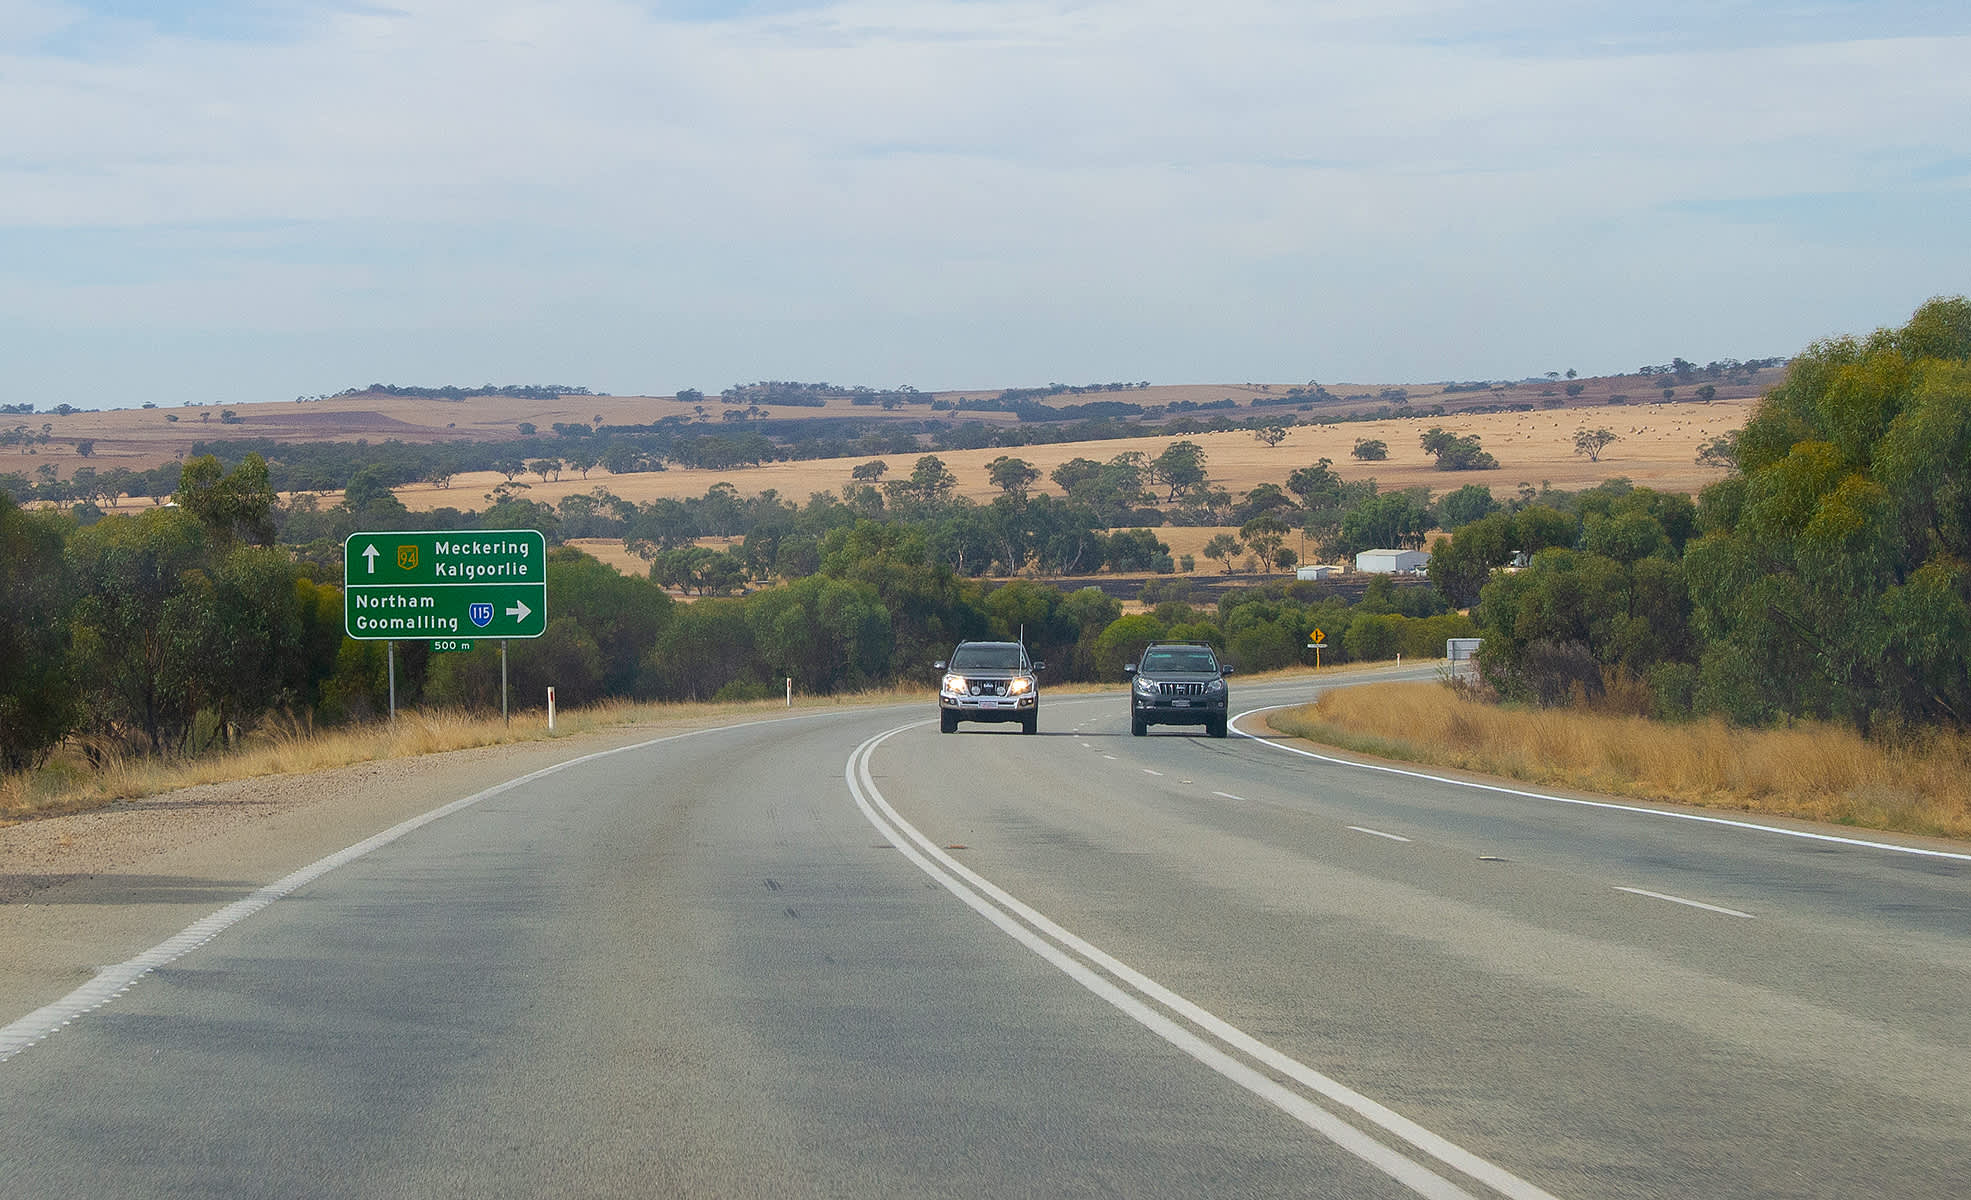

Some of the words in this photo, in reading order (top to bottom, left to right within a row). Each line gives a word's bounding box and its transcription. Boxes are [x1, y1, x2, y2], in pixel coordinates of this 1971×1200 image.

[435, 541, 529, 557] Meckering
[400, 552, 416, 565] 94
[435, 562, 528, 580] Kalgoorlie
[356, 594, 435, 608] Northam
[473, 606, 490, 619] 115
[356, 615, 458, 632] Goomalling
[434, 641, 457, 650] 500
